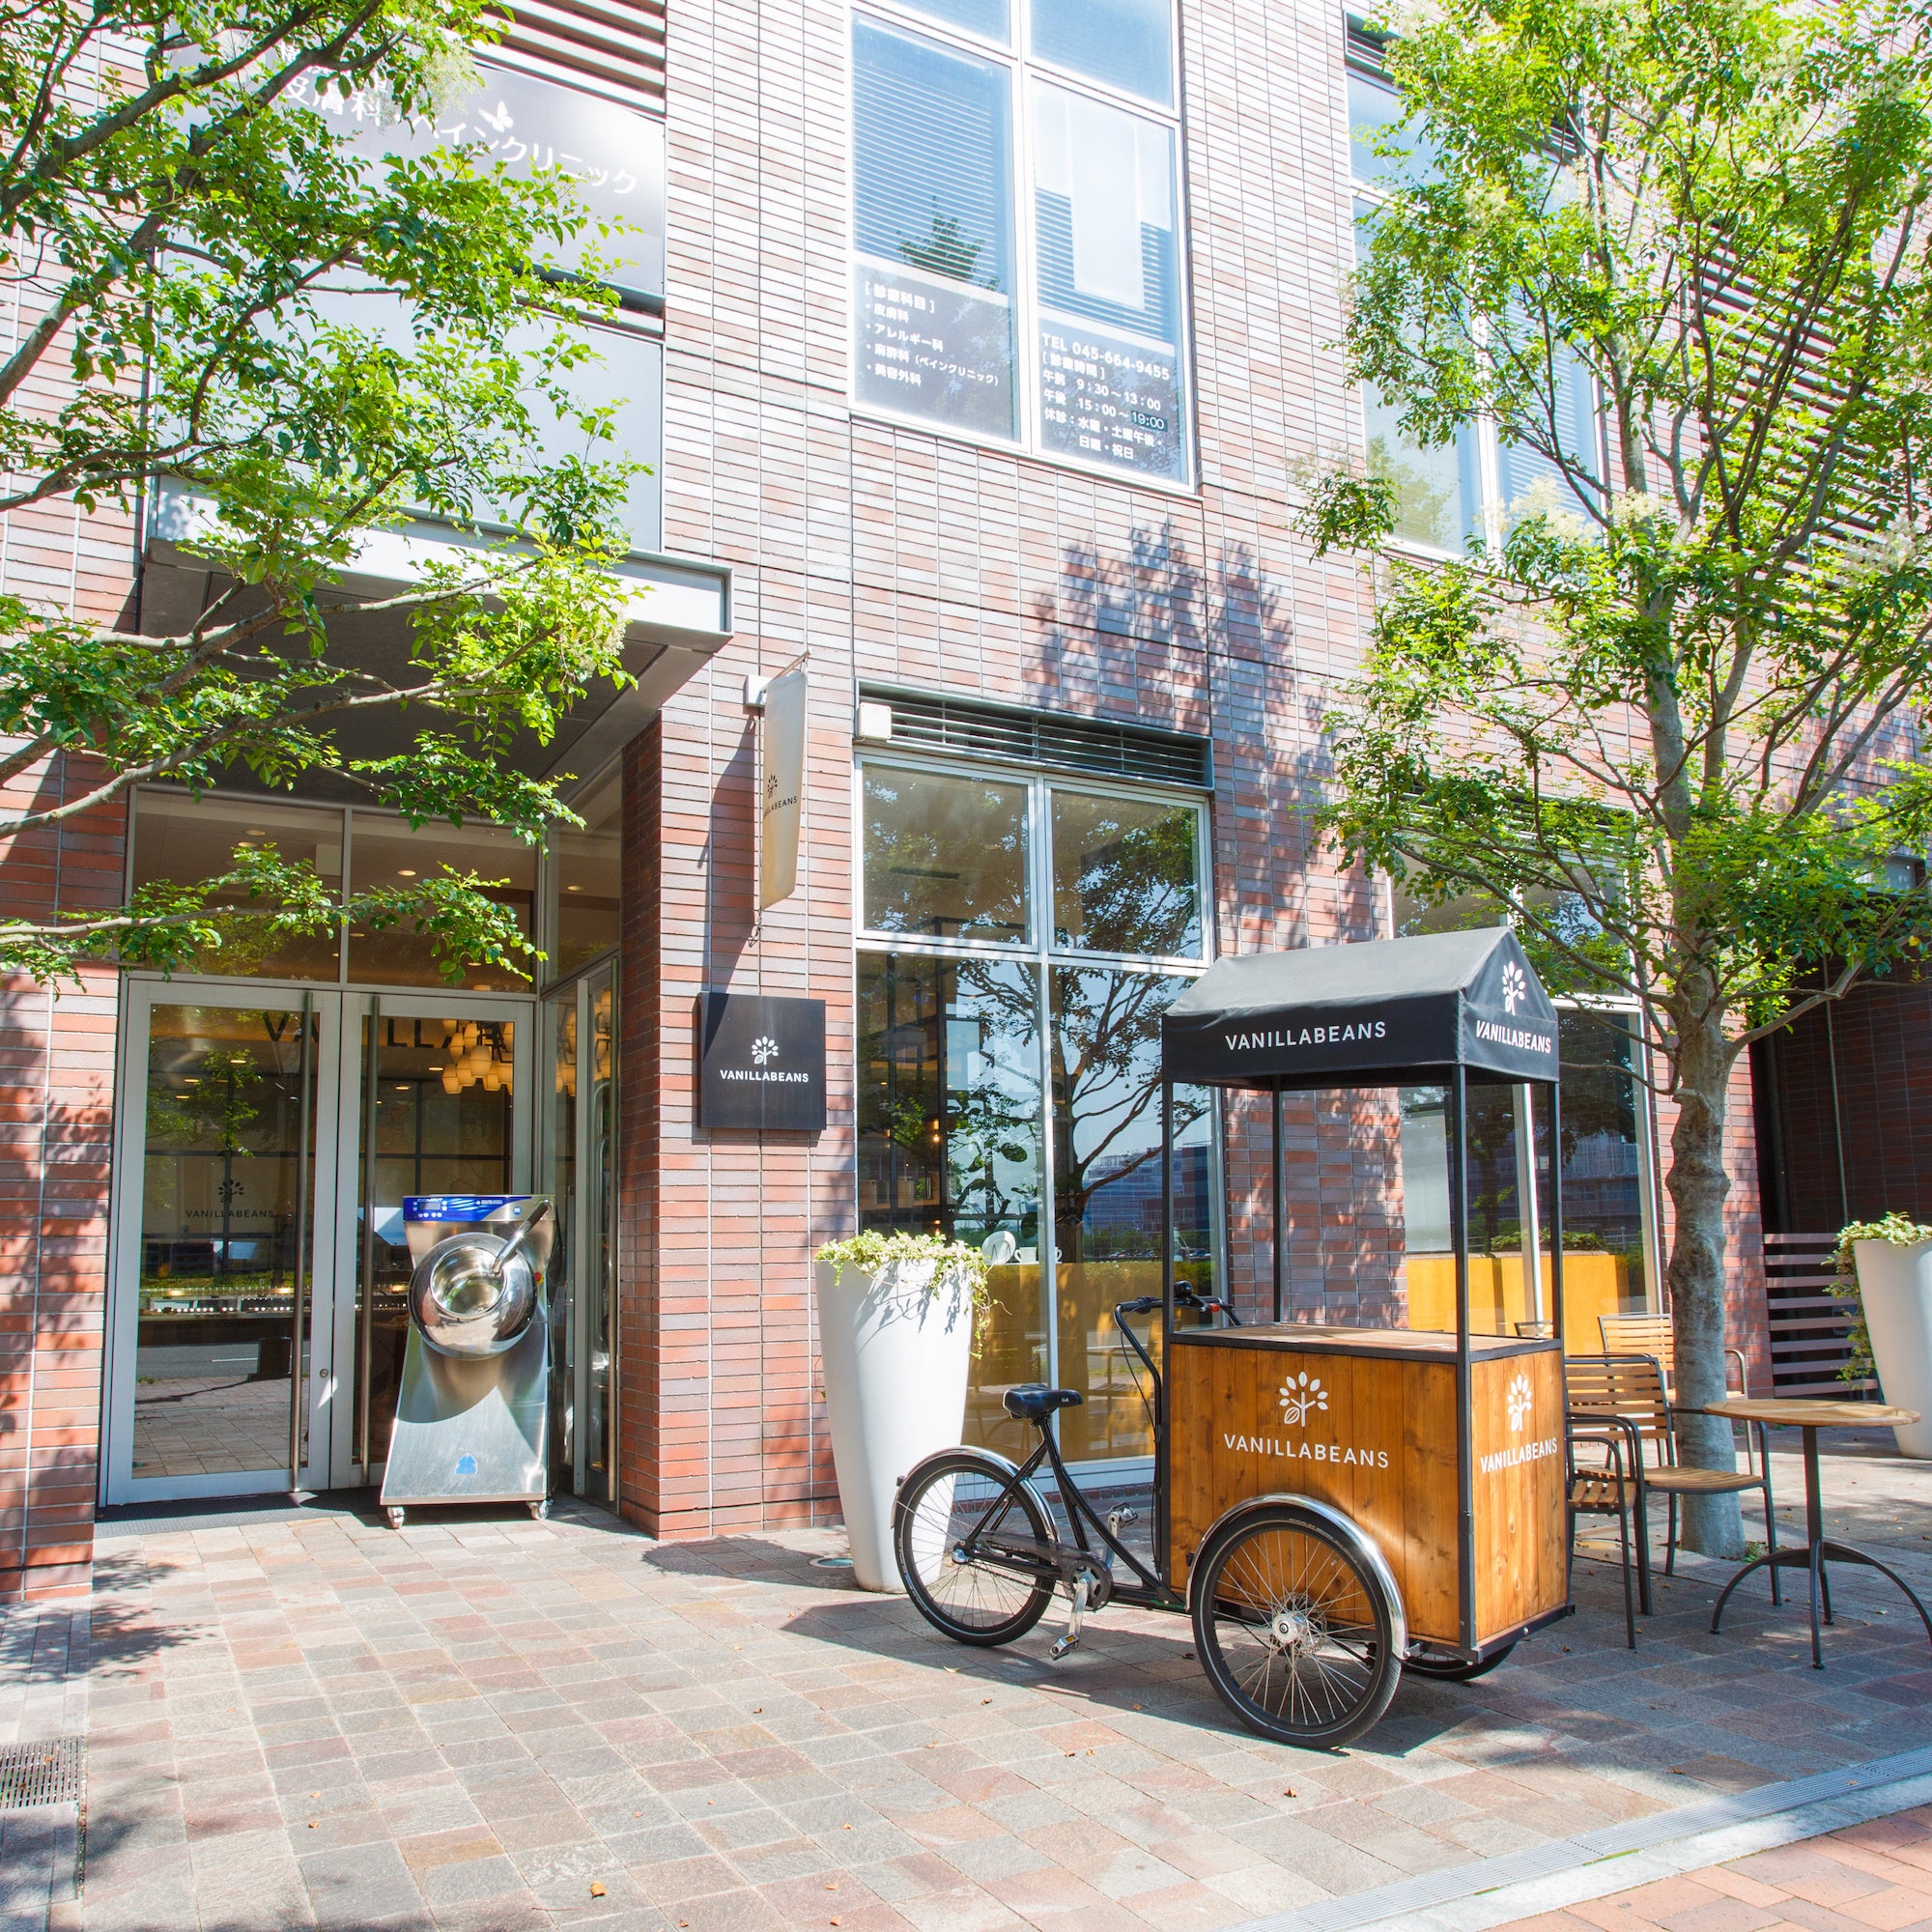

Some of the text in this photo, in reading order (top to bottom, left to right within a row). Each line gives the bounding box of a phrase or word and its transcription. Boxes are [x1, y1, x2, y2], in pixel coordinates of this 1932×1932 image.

[1042, 333, 1170, 381] TEL 045-664-9455
[1043, 369, 1065, 386] 午前
[1043, 388, 1066, 406] 午後
[1225, 1020, 1386, 1051] VANILLABEANS
[1475, 1020, 1551, 1054] VANILLABEANS
[720, 1069, 810, 1083] VANILLABEANS
[1224, 1434, 1389, 1468] VANILLABEANS
[1480, 1437, 1558, 1473] VANILLABEANS
